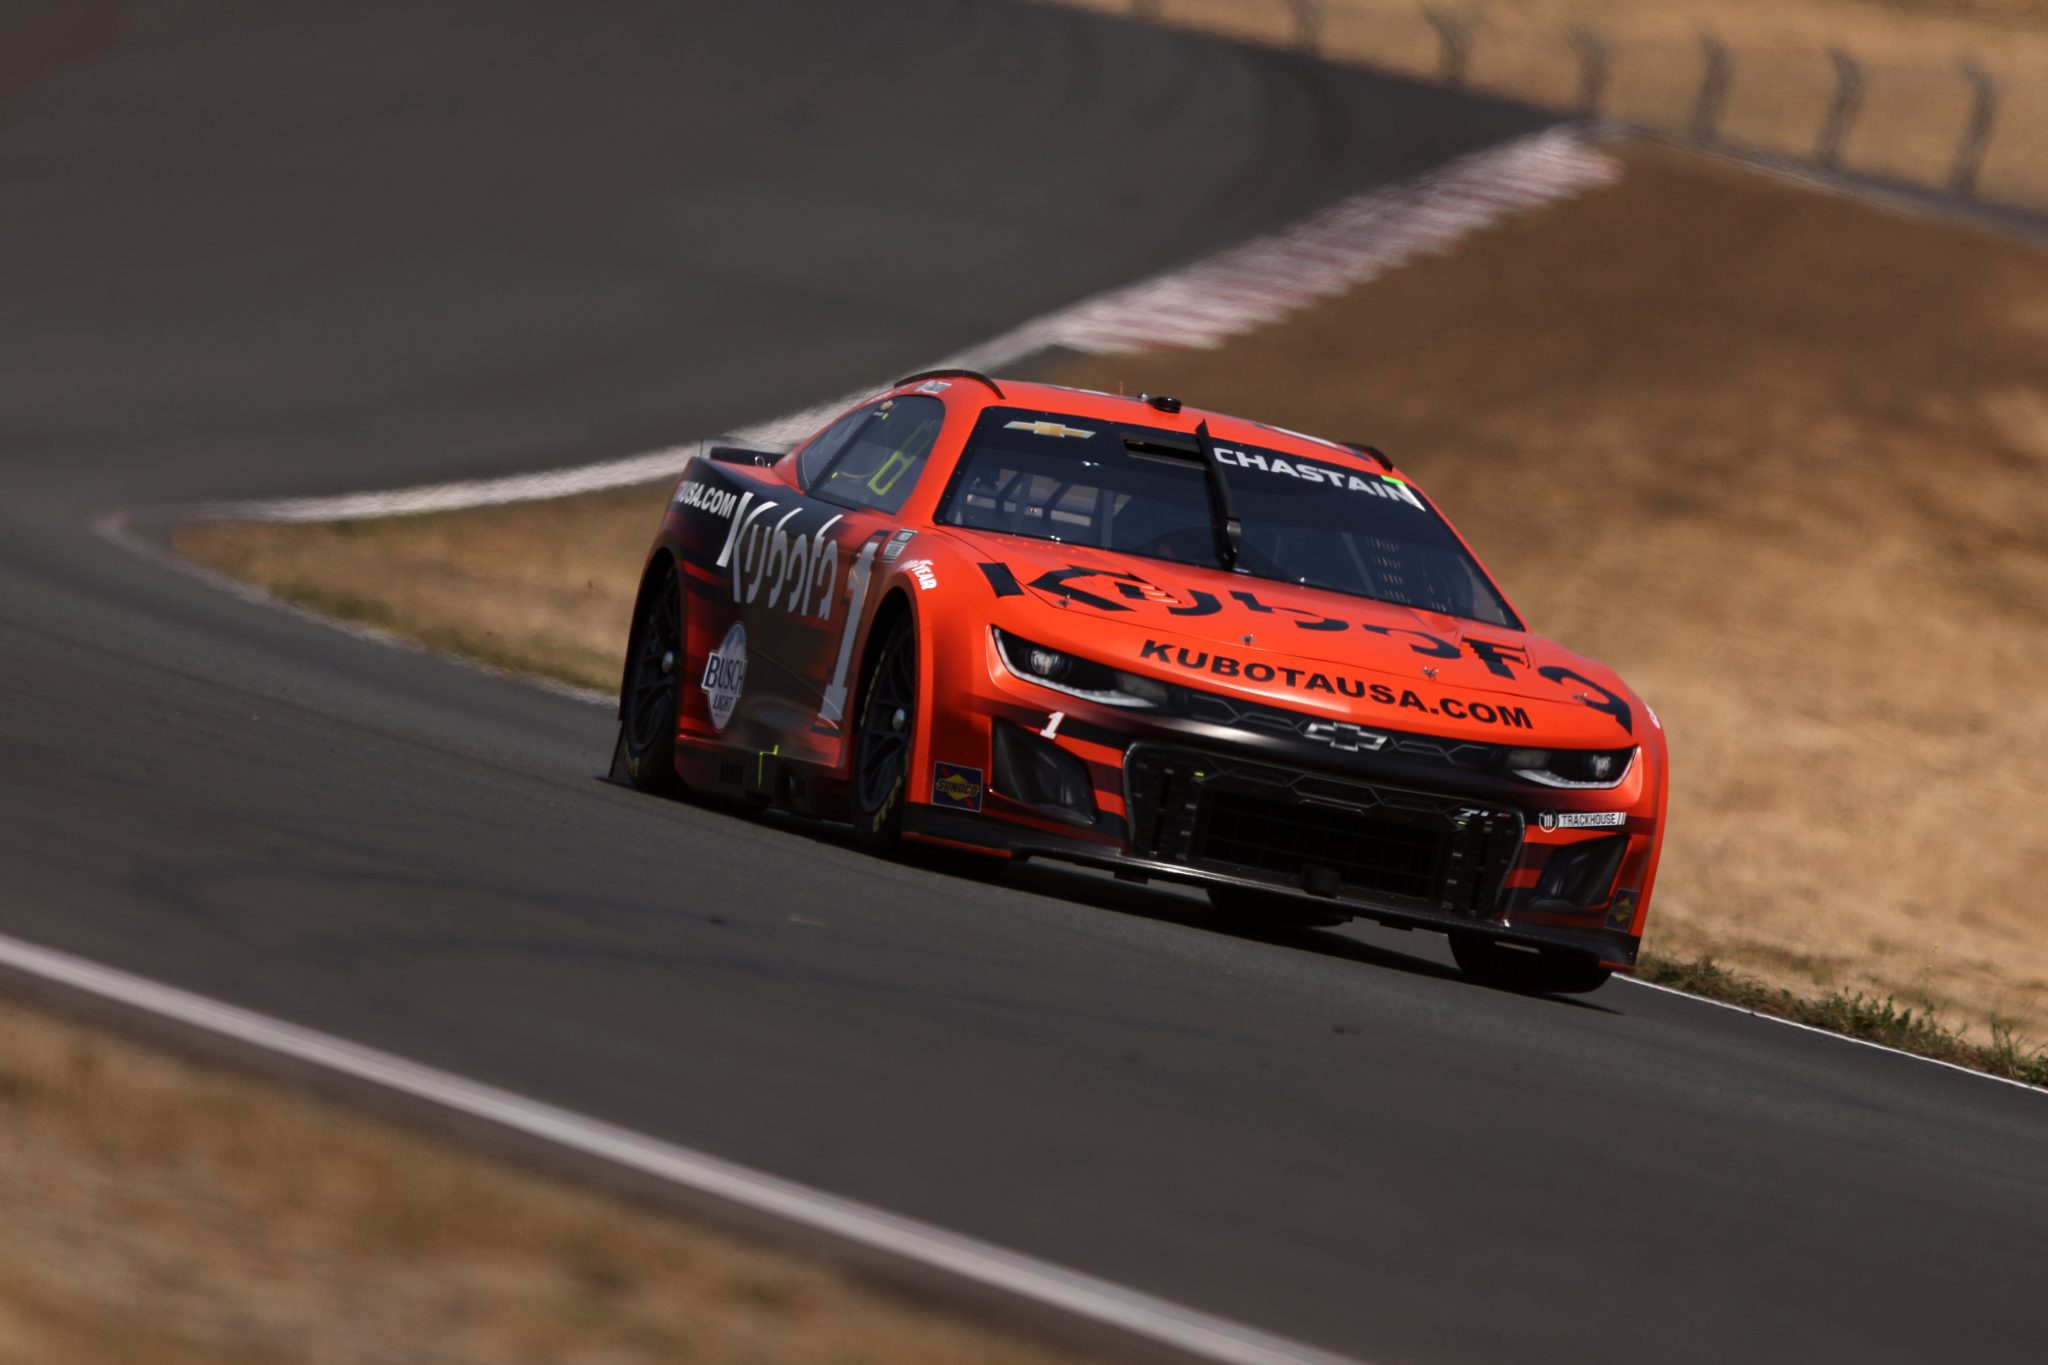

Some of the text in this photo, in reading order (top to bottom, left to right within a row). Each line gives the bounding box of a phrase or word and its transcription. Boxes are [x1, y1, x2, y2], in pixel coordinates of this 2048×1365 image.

[1212, 446, 1410, 504] CHASTAIN
[715, 491, 843, 621] Kubota
[817, 541, 879, 722] 1
[976, 561, 1633, 738] Kubota
[703, 654, 745, 695] BUSCH
[1140, 638, 1533, 731] KUBOTAUSA.COM
[712, 694, 734, 712] LIGHT
[1039, 711, 1065, 740] 1
[935, 778, 979, 797] SUNOCO
[1560, 813, 1617, 827] TRACKHOUSE
